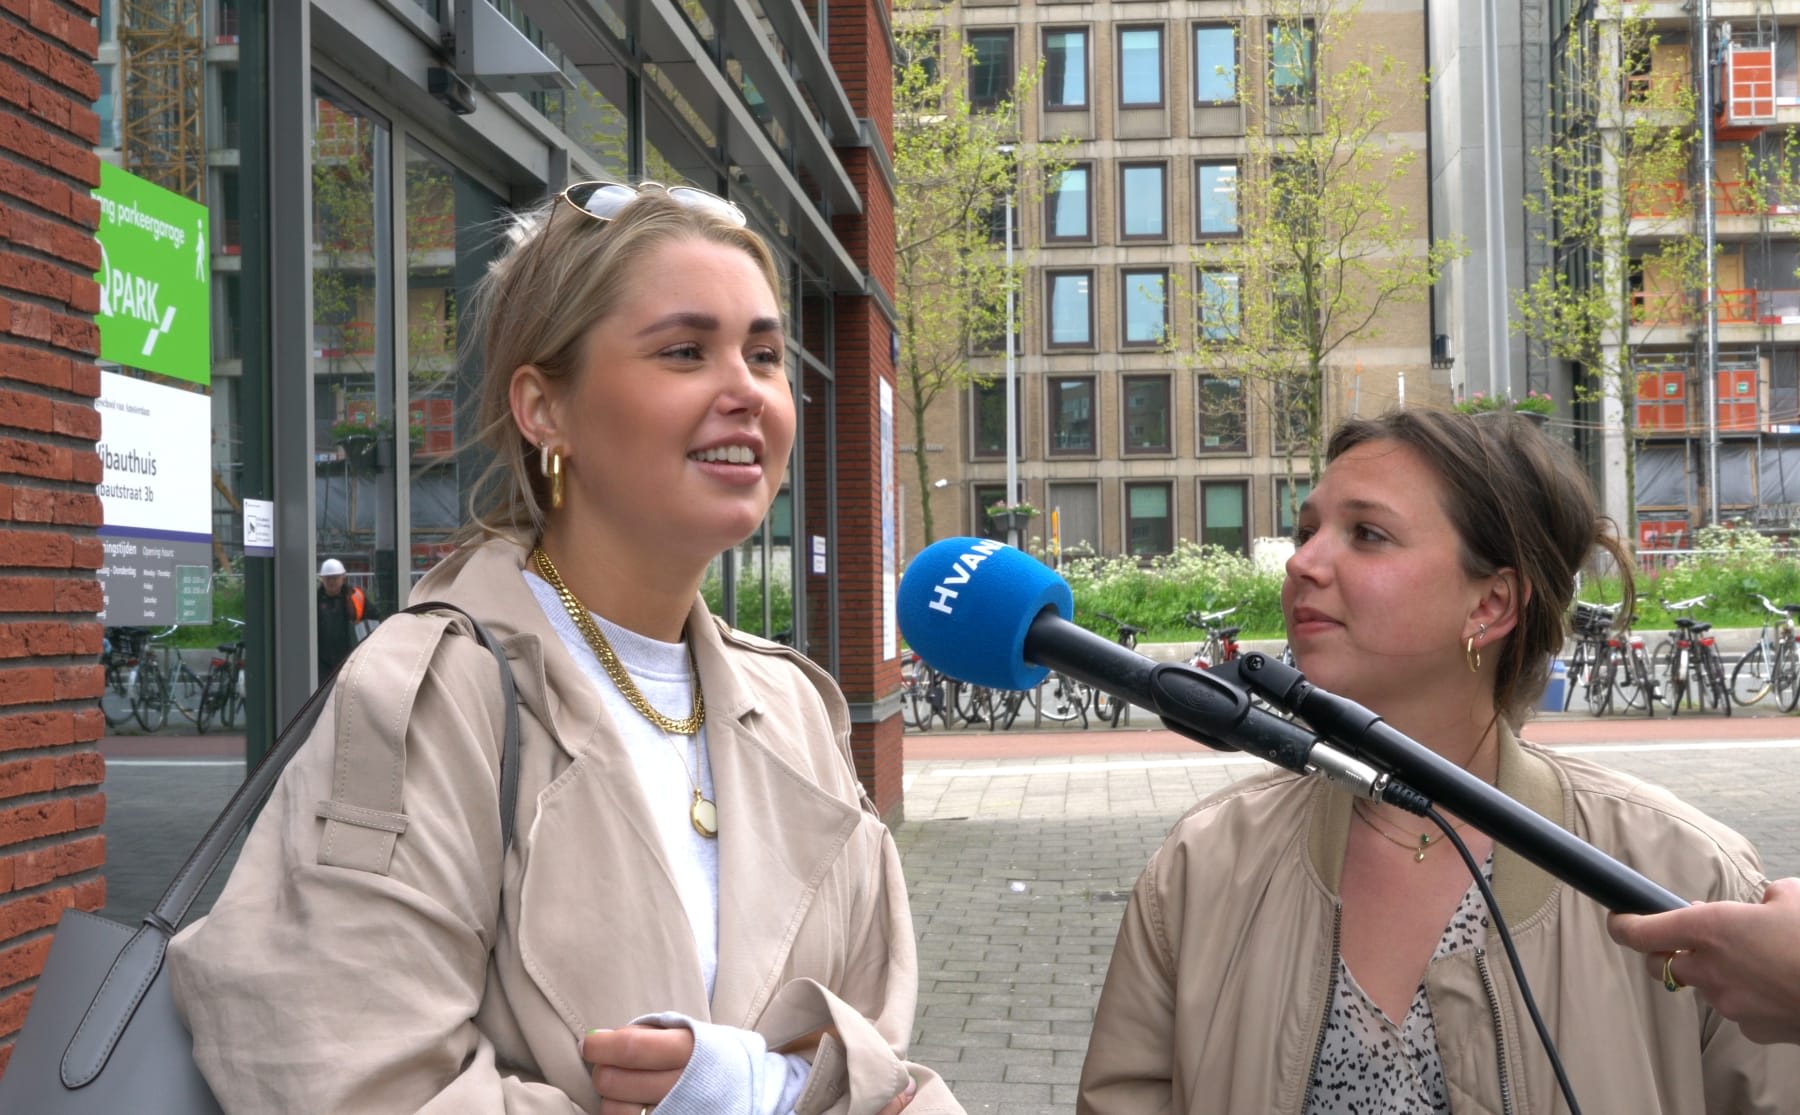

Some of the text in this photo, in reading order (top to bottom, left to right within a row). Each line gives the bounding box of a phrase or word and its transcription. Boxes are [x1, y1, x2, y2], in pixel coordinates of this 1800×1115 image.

[118, 200, 184, 249] parkeergarage
[144, 486, 154, 502] 3b
[103, 541, 136, 557] ningstijden
